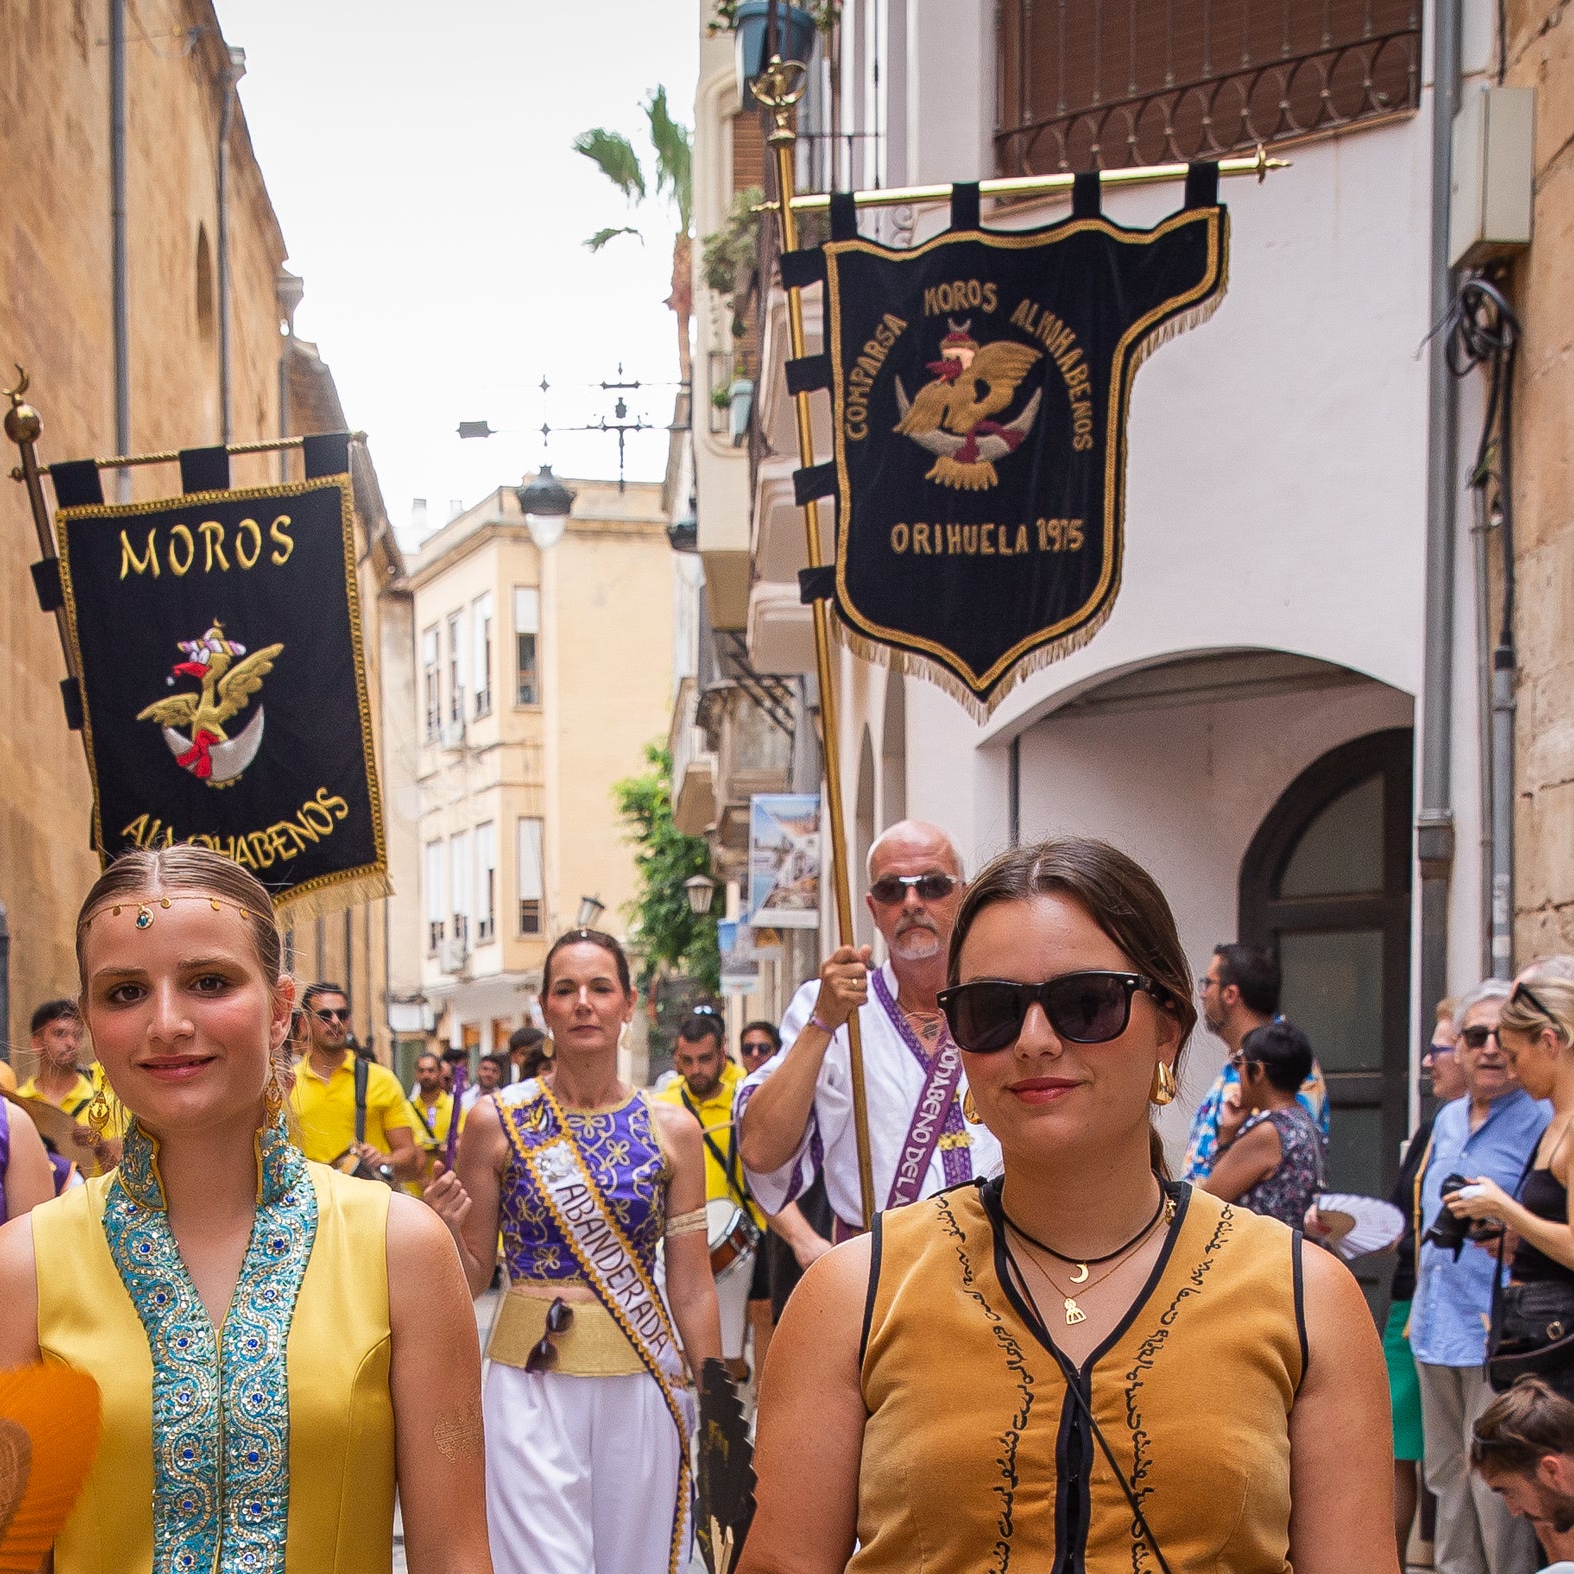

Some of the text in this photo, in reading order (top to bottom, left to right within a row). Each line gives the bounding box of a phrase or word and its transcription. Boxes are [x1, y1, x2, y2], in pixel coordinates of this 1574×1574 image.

[845, 312, 909, 442] COMPARSA
[924, 278, 998, 317] MOROS
[119, 513, 294, 582] MOROS
[890, 521, 1029, 556] ORIHUELA
[896, 1145, 927, 1189] DEL
[555, 1183, 669, 1357] ABANDERADA
